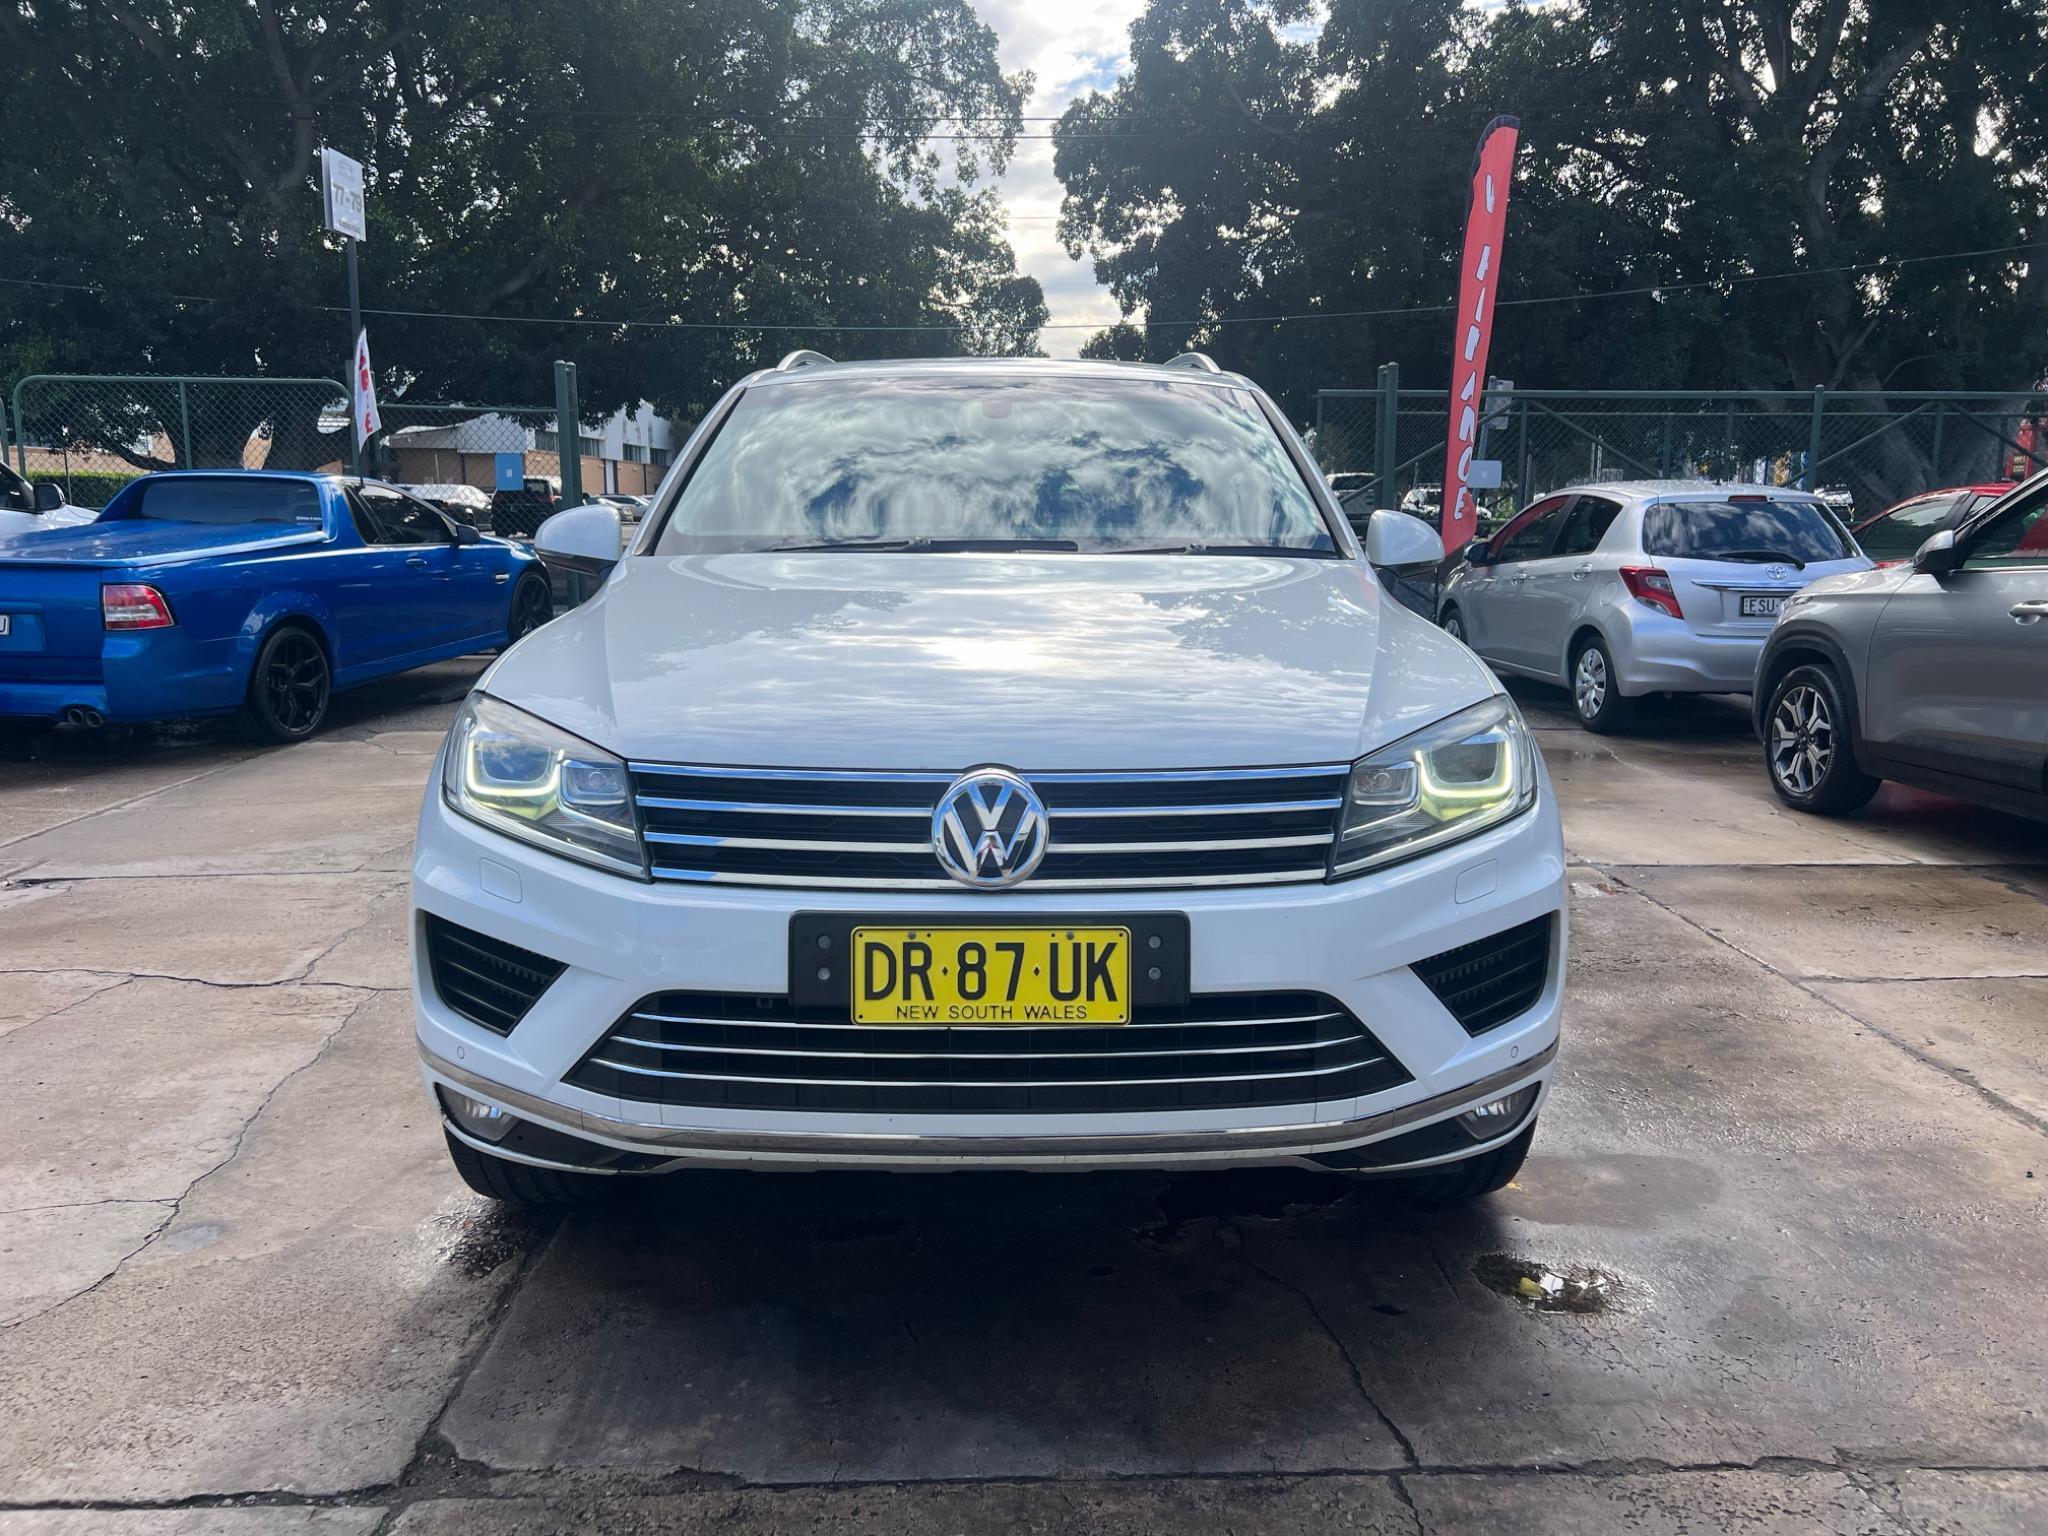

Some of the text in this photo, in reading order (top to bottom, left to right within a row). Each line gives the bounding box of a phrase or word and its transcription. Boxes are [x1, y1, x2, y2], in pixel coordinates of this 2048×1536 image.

[896, 1004, 1087, 1019] NEW SOUTH WALES
